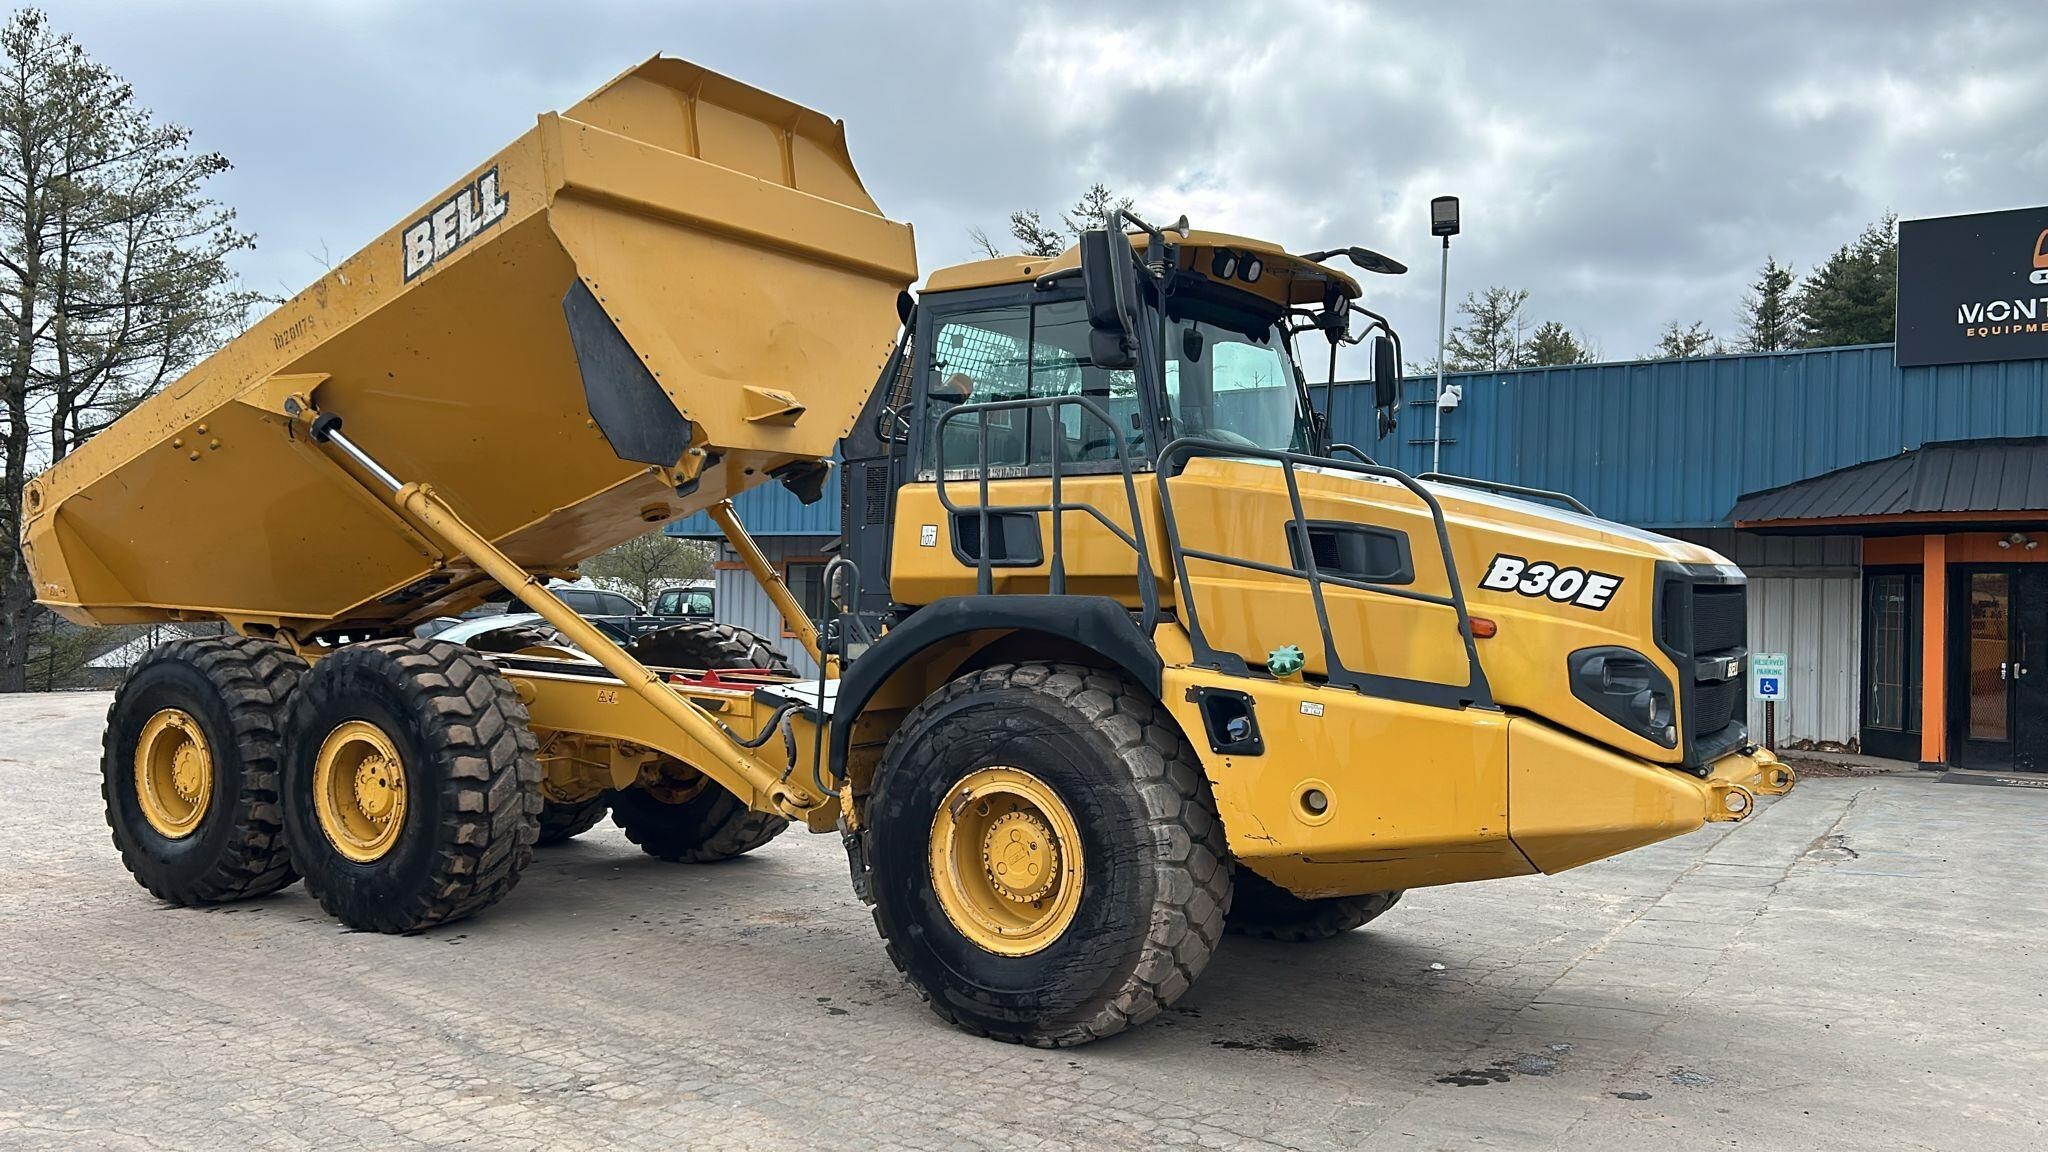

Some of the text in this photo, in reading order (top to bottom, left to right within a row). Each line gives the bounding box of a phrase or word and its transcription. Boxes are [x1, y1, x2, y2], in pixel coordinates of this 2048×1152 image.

[403, 164, 509, 285] BELL
[1480, 554, 1623, 610] B30E
[1756, 668, 1782, 676] PARKING
